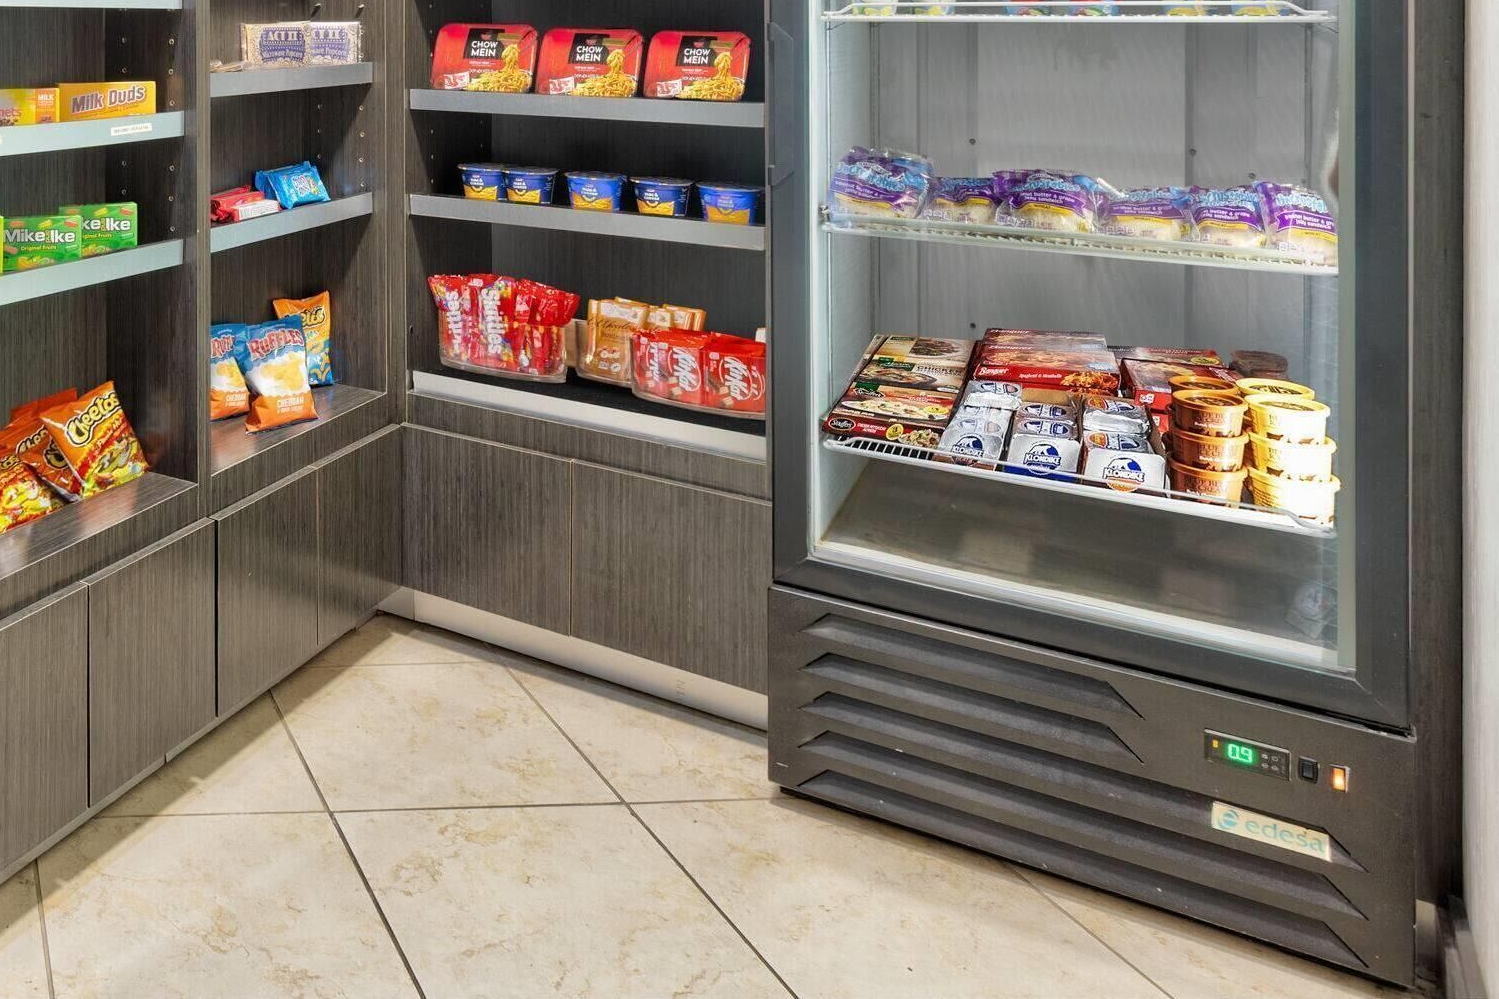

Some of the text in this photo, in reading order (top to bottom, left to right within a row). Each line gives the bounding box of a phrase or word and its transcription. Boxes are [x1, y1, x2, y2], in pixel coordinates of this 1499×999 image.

[471, 40, 499, 49] CHOW
[471, 48, 497, 57] MEIN
[576, 45, 604, 54] CHOW
[683, 48, 711, 56] CHOW
[576, 53, 602, 62] MEIN
[683, 56, 709, 65] MEIN
[37, 94, 55, 102] MILK
[71, 85, 146, 114] Milk Duds
[83, 218, 131, 232] ke Ike
[5, 229, 75, 244] Mike Ike
[66, 391, 120, 443] Cheetos
[1244, 818, 1327, 854] edesa
